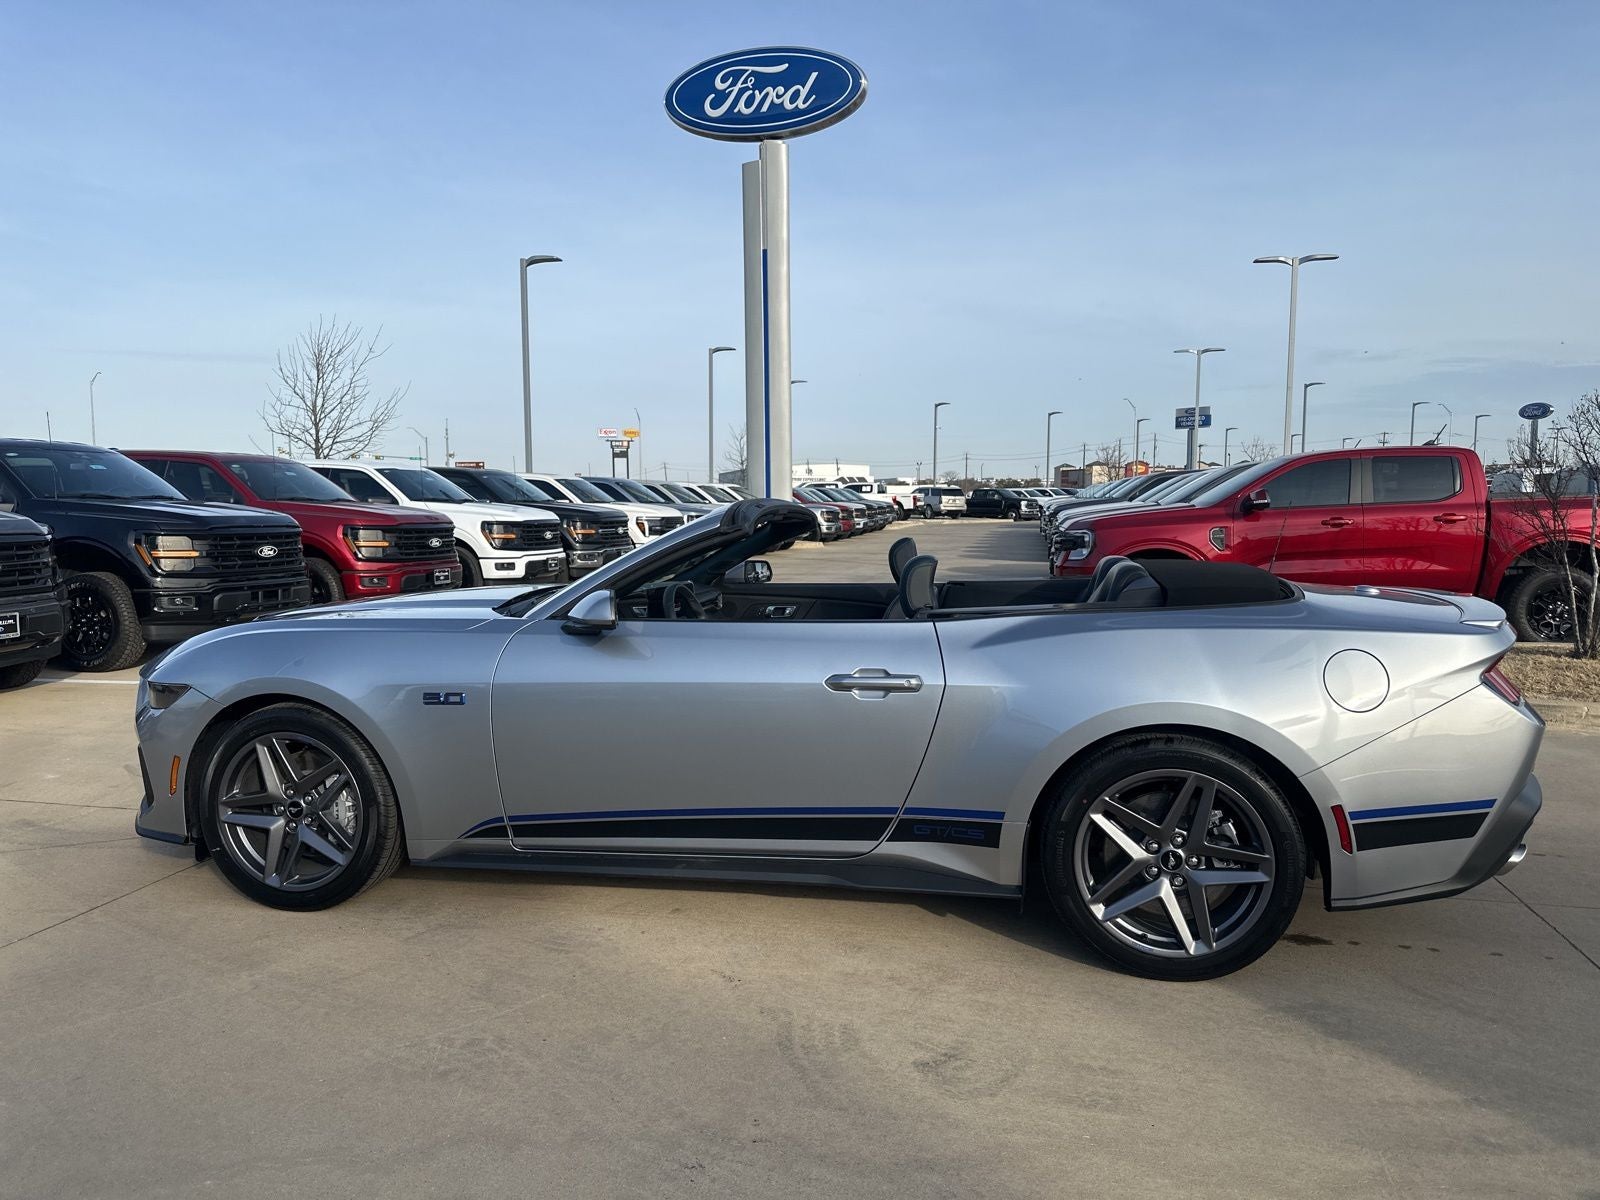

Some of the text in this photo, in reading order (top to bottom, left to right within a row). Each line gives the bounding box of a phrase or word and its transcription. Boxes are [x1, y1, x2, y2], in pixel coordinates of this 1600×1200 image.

[704, 63, 818, 118] Ford
[1524, 405, 1543, 416] Ford
[260, 547, 276, 556] Ford
[423, 692, 465, 705] 5.0
[913, 824, 985, 840] GT/CS
